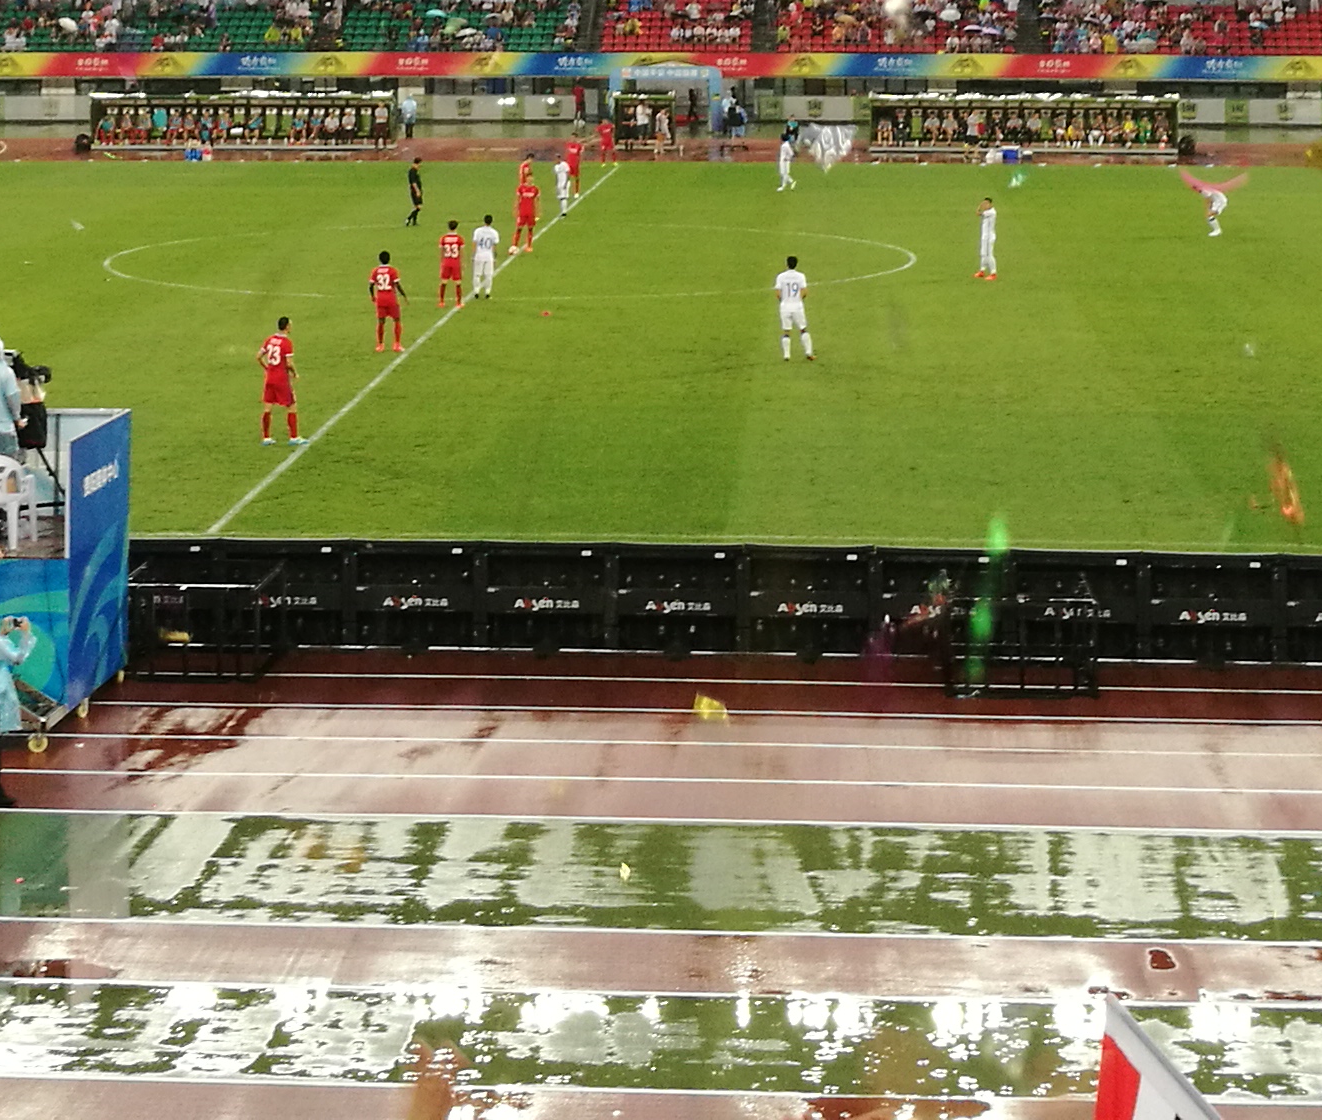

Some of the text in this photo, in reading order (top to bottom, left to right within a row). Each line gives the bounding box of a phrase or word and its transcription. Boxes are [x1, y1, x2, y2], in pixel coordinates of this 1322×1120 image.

[444, 243, 459, 258] 33
[478, 238, 493, 250] 40
[377, 273, 393, 290] 32
[786, 282, 799, 298] 19
